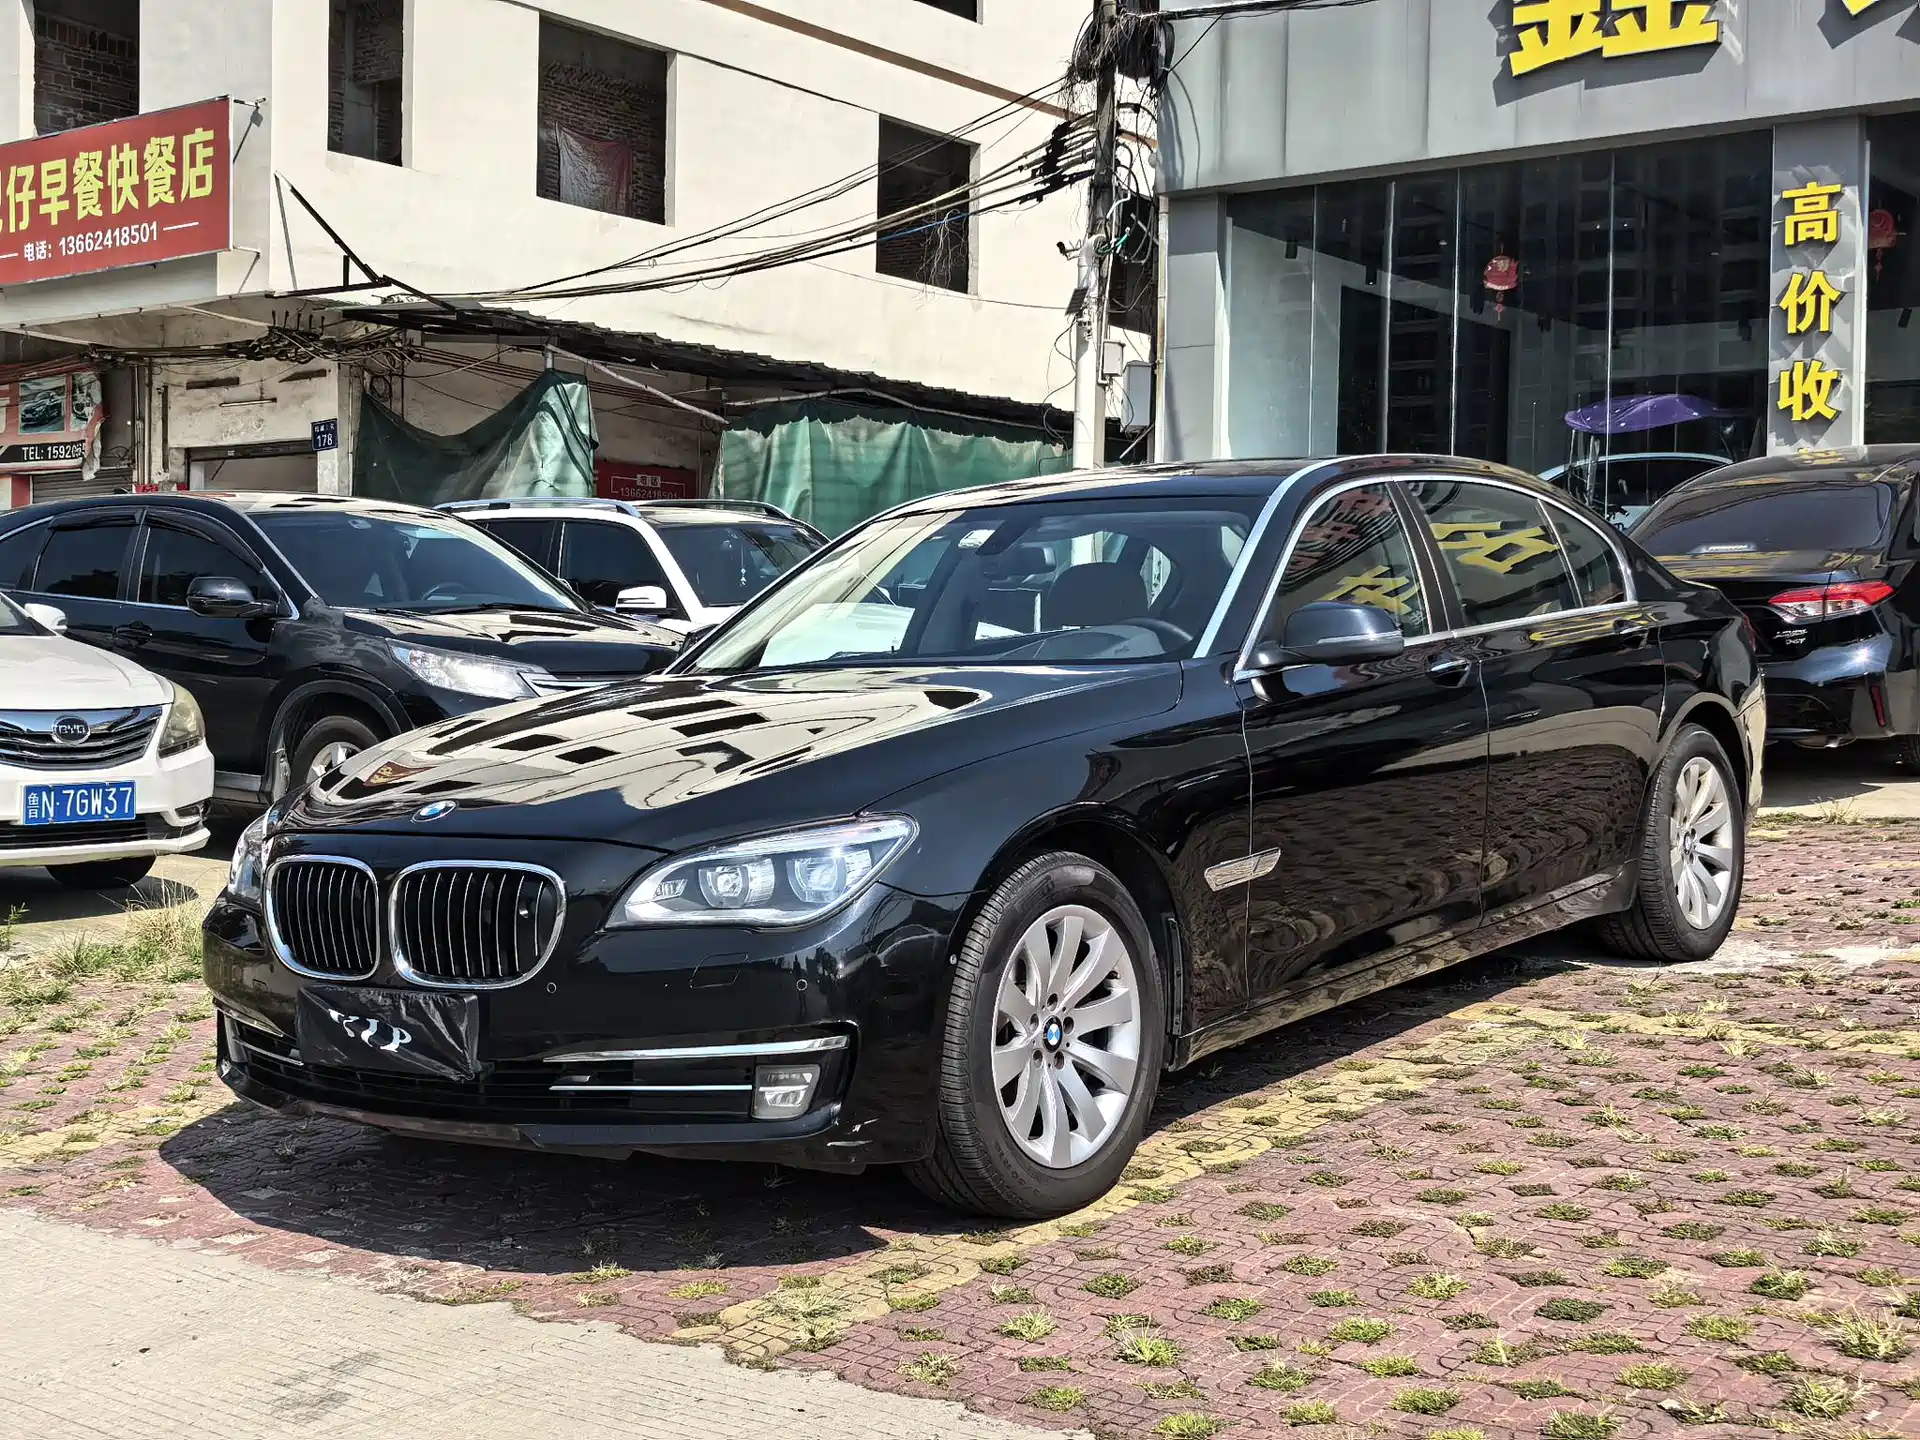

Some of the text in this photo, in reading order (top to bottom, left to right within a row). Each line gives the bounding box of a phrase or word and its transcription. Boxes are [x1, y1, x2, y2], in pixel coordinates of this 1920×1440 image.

[59, 221, 158, 256] 13662418501
[317, 433, 333, 447] 178
[22, 446, 44, 460] TEL:
[59, 724, 86, 735] BYD
